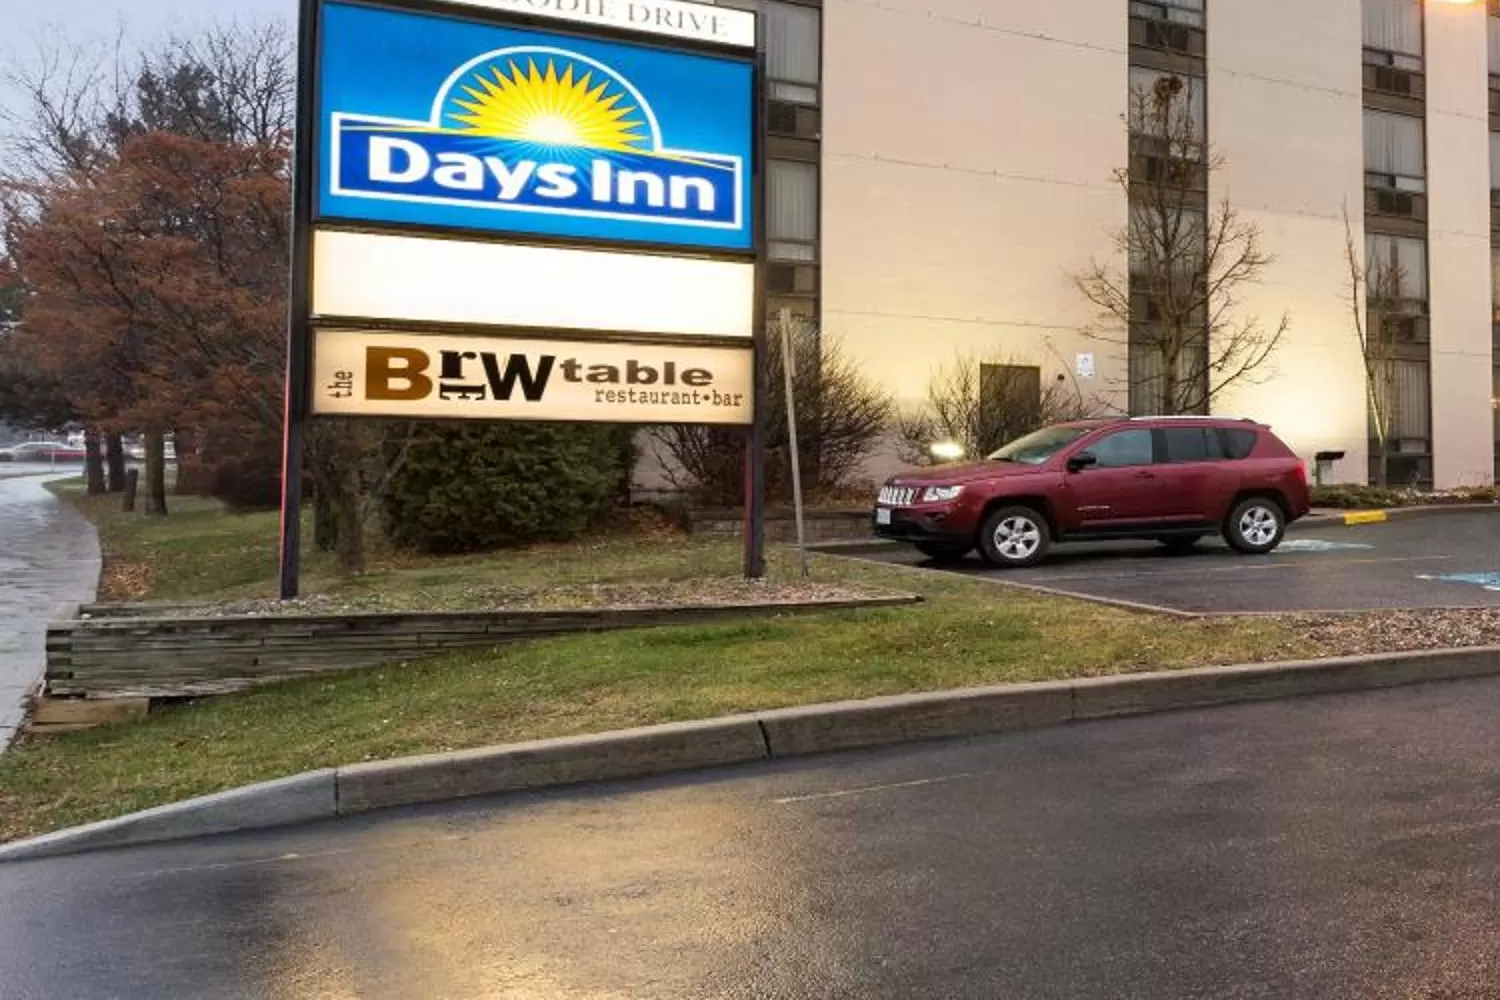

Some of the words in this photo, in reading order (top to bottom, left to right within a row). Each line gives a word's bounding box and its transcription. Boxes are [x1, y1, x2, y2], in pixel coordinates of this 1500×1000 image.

[628, 3, 729, 37] DRIVE
[368, 135, 577, 200] Days
[592, 158, 715, 211] Inn
[327, 370, 353, 398] the
[560, 358, 713, 386] table
